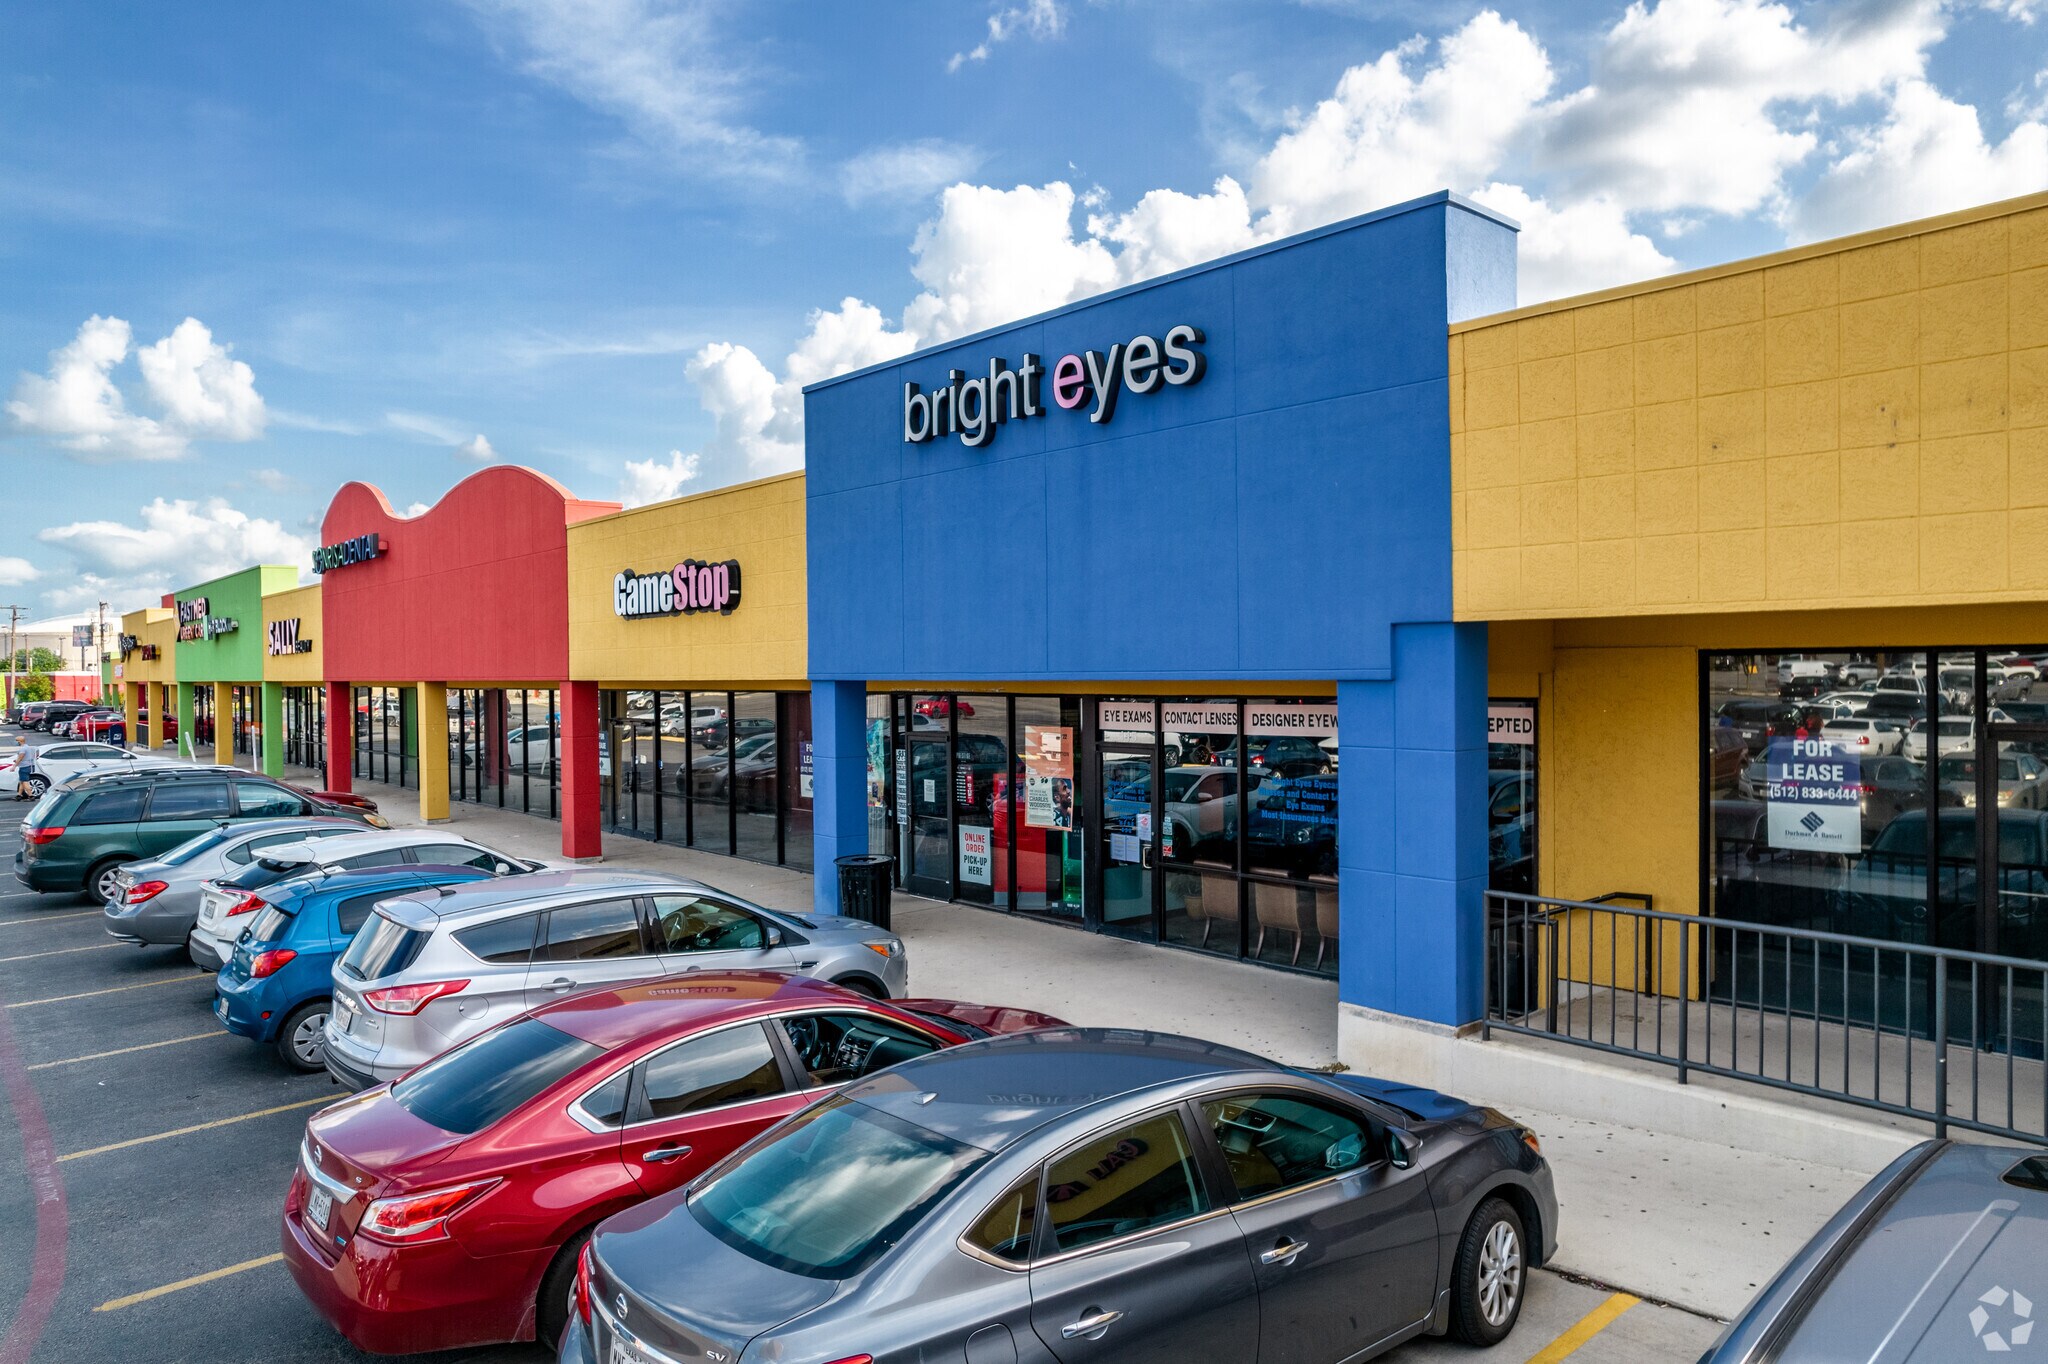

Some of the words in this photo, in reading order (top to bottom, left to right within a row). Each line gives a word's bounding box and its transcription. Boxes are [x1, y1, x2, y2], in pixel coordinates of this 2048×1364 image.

[904, 353, 1045, 447] bright
[1053, 325, 1207, 424] eyes
[613, 560, 738, 619] GameStop
[268, 618, 300, 656] SALLY
[1104, 710, 1121, 723] EYE
[1122, 710, 1152, 724] EXAMS
[1164, 711, 1203, 725] CONTACT
[1205, 711, 1238, 726] LENSES
[1252, 712, 1305, 728] DESIGNER
[1308, 713, 1338, 728] EYEW
[1488, 717, 1532, 733] EPTED
[1793, 739, 1832, 757] FOR
[1782, 763, 1844, 782] LEASE
[1295, 778, 1311, 789] Eyes
[1313, 779, 1338, 790] Eyecar
[1286, 789, 1300, 799] and
[1302, 790, 1329, 801] Contact
[1770, 785, 1798, 800] (512)
[1802, 786, 1858, 801] 833-6444
[1286, 799, 1300, 811] Eye
[1301, 801, 1325, 812] Exams
[1261, 809, 1279, 820] Most
[964, 832, 986, 844] ONLINE
[965, 843, 985, 854] ORDER
[963, 854, 988, 865] PICK-UP
[968, 865, 983, 876] HERE
[706, 1350, 728, 1363] SV
